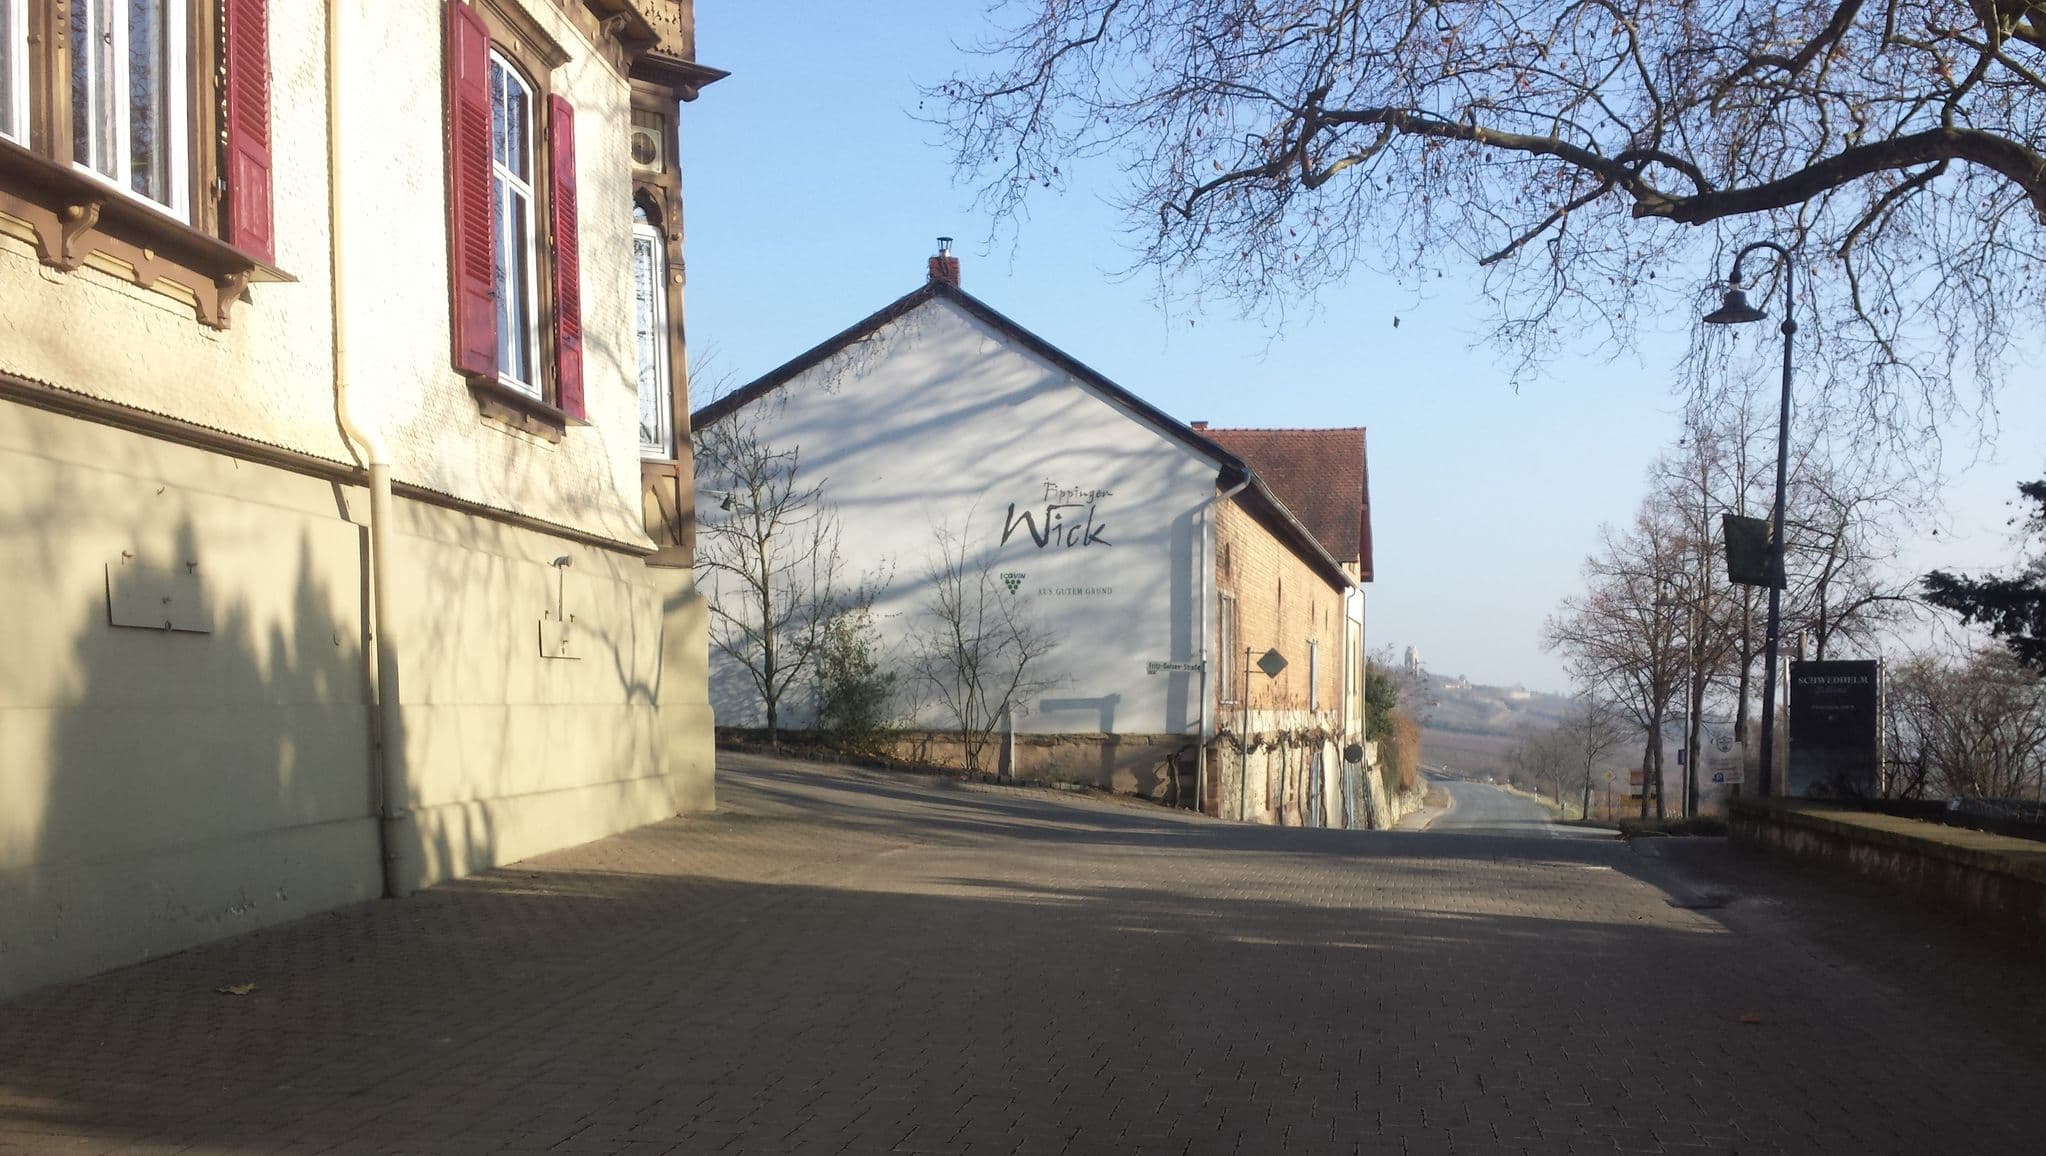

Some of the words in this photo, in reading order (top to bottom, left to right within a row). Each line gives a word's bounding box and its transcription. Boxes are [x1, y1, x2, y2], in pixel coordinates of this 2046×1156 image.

[1000, 502, 1112, 548] Wick
[1038, 587, 1053, 595] AUS
[1055, 587, 1083, 595] GUTEM
[1085, 587, 1113, 595] GRUND
[1797, 675, 1869, 685] SCHWEDHELM
